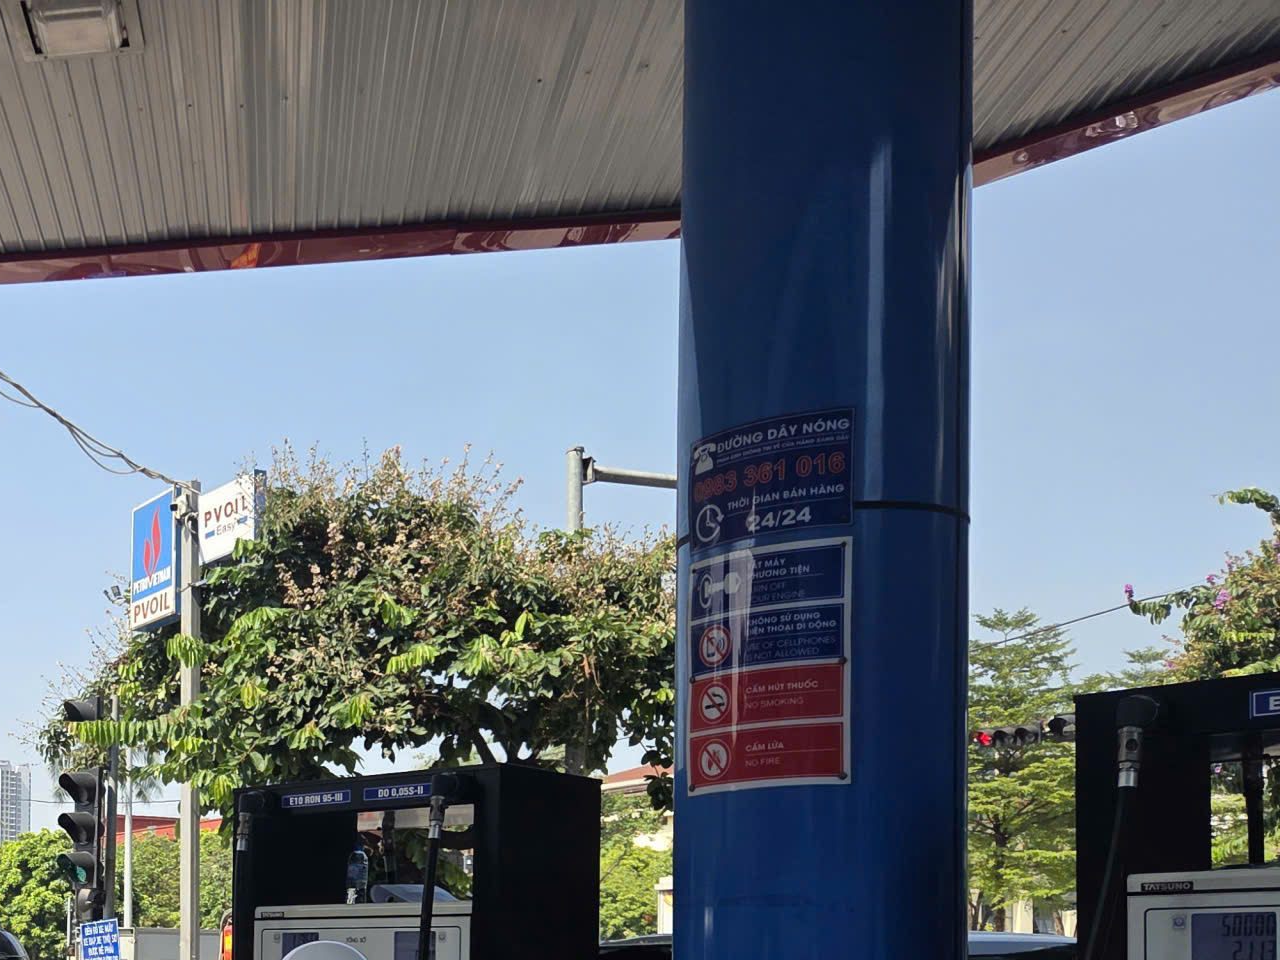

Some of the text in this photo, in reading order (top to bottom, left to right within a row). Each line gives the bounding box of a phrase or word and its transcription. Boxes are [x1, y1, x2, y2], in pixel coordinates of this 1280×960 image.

[717, 418, 850, 454] ĐƯỜNG DÂY NÓNG
[744, 458, 785, 487] 361
[796, 451, 845, 478] 016
[727, 496, 750, 511] THỜI
[783, 487, 807, 499] BÁN
[810, 483, 844, 496] HÀNG
[204, 495, 248, 528] PVOIL
[748, 505, 812, 532] 24/24
[216, 520, 236, 536] Easy
[764, 557, 786, 567] MÁY
[752, 564, 810, 579] HƯƠNG TIỆN
[134, 592, 171, 623] PVOIL
[794, 612, 821, 621] DỤNG
[767, 623, 794, 633] THOẠI
[774, 648, 820, 658] ALLOWED
[745, 678, 819, 694] CẤM HÚT THUỐC
[745, 697, 804, 709] NO SMOKING
[745, 741, 766, 752] CẤM
[745, 756, 781, 767] NO FIRE
[378, 786, 423, 797] DO 0,05S-II
[290, 792, 343, 806] E10 RON 95-III
[1143, 882, 1191, 891] TATSUNO
[1222, 914, 1276, 937] 50000
